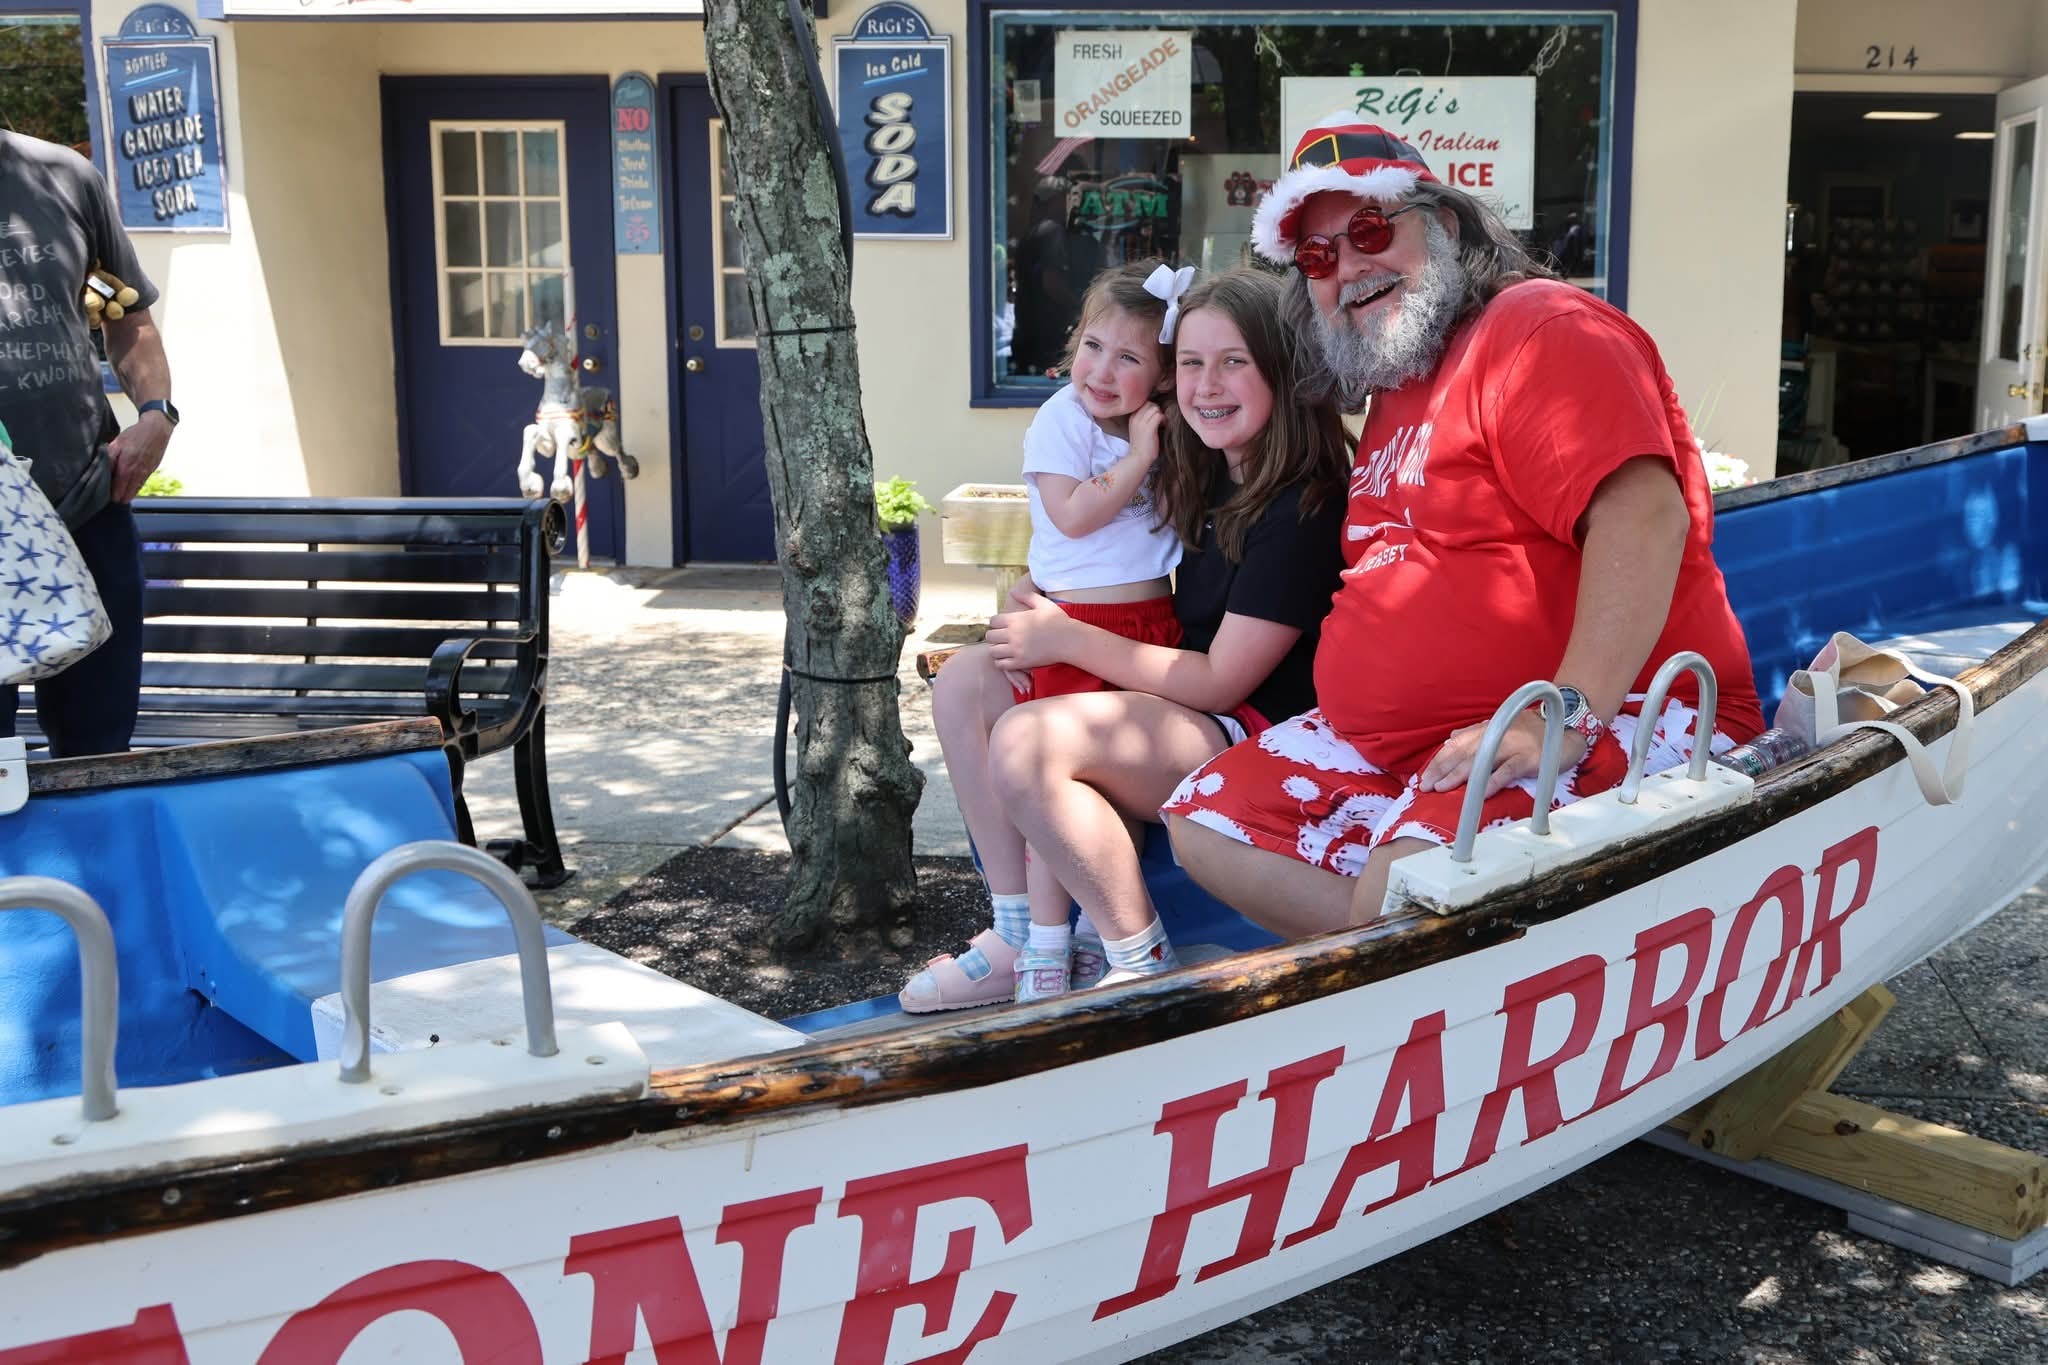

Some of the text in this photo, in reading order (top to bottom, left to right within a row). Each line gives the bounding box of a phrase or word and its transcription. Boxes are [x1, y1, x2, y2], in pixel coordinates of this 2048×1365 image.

[1073, 44, 1123, 60] FRESH
[1865, 45, 1919, 70] 214
[865, 53, 921, 78] Ice Cold
[1063, 38, 1180, 128] ORANGEADE
[130, 86, 184, 121] WATER
[615, 107, 651, 133] NO
[1099, 110, 1182, 126] SQUEEZED
[123, 113, 205, 158] GATORADE
[1417, 129, 1502, 152] Italian
[866, 91, 918, 215] SODA
[135, 157, 172, 189] ICED
[1448, 162, 1495, 188] ICE
[153, 181, 198, 219] SODA
[1080, 191, 1169, 218] ATM
[0, 244, 57, 269] EYES
[1092, 825, 1879, 1322] HARBOR
